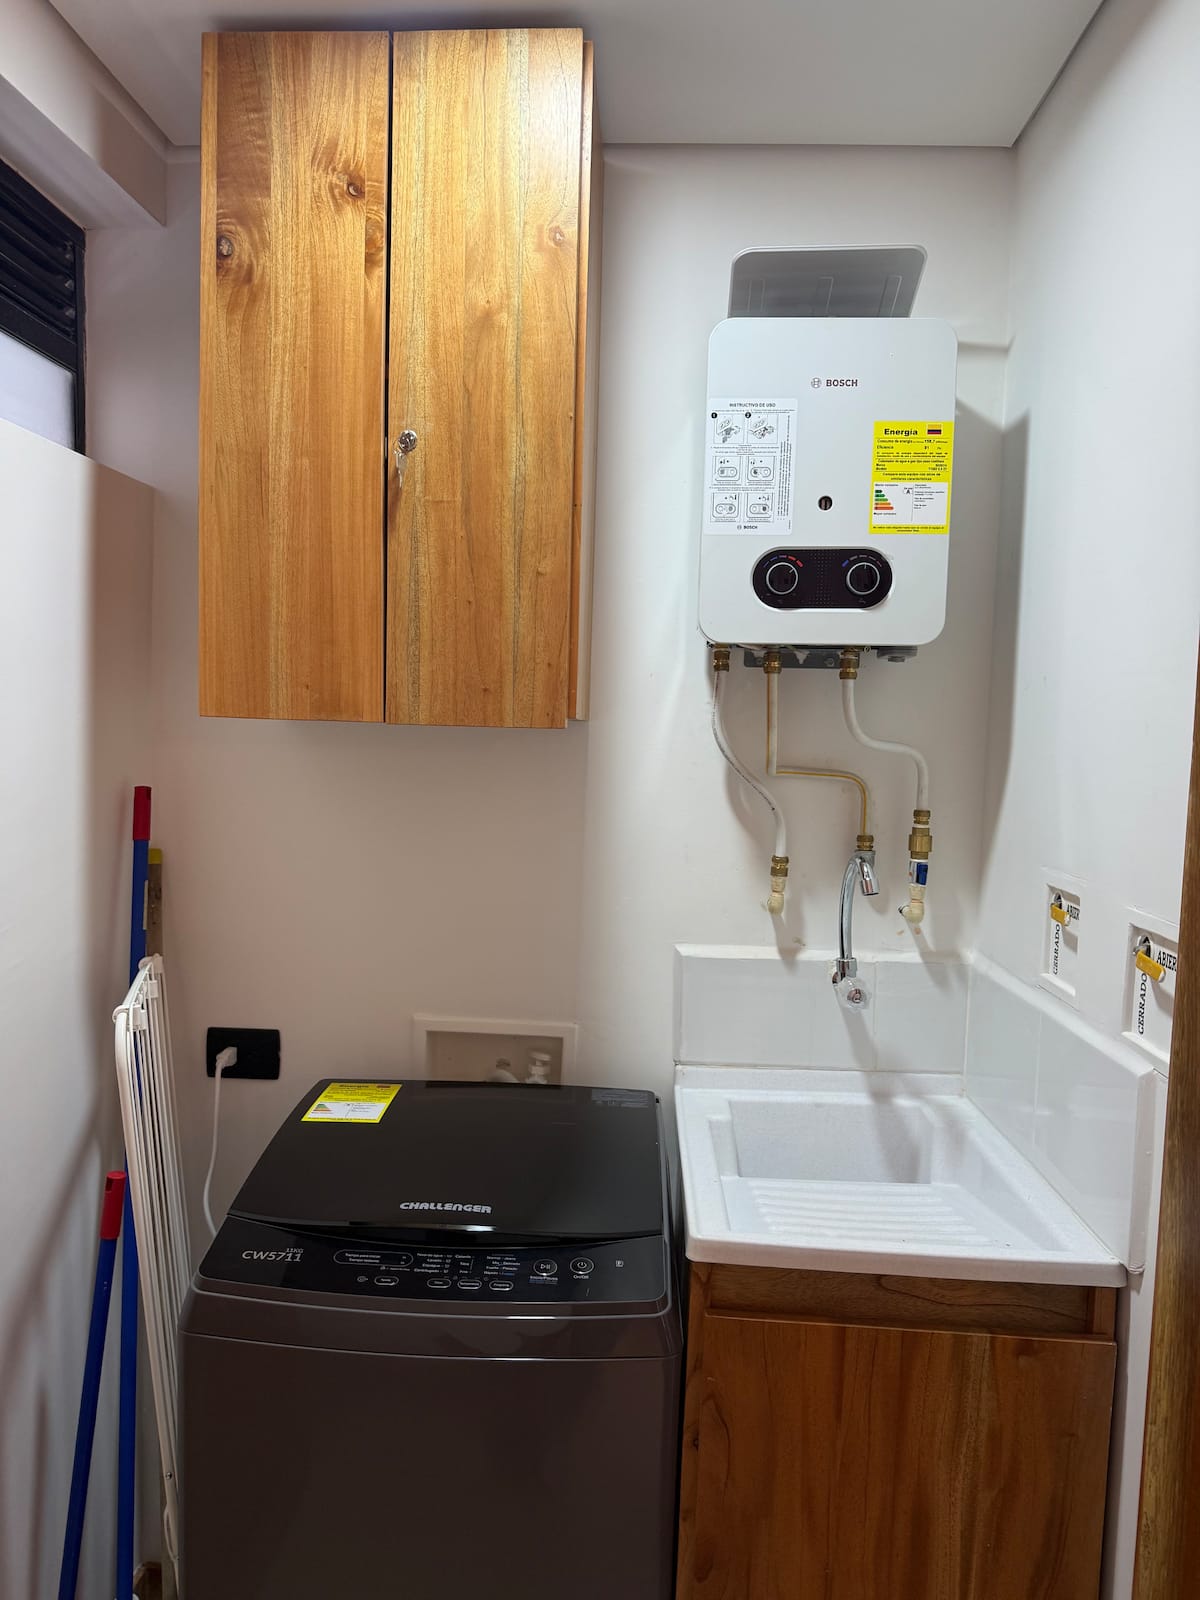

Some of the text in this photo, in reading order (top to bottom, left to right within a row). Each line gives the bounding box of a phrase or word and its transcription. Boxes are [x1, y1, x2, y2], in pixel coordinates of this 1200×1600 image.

[826, 379, 858, 387] BOSCH
[399, 1202, 492, 1214] CHALLENGER
[242, 1250, 302, 1262] CW5711
